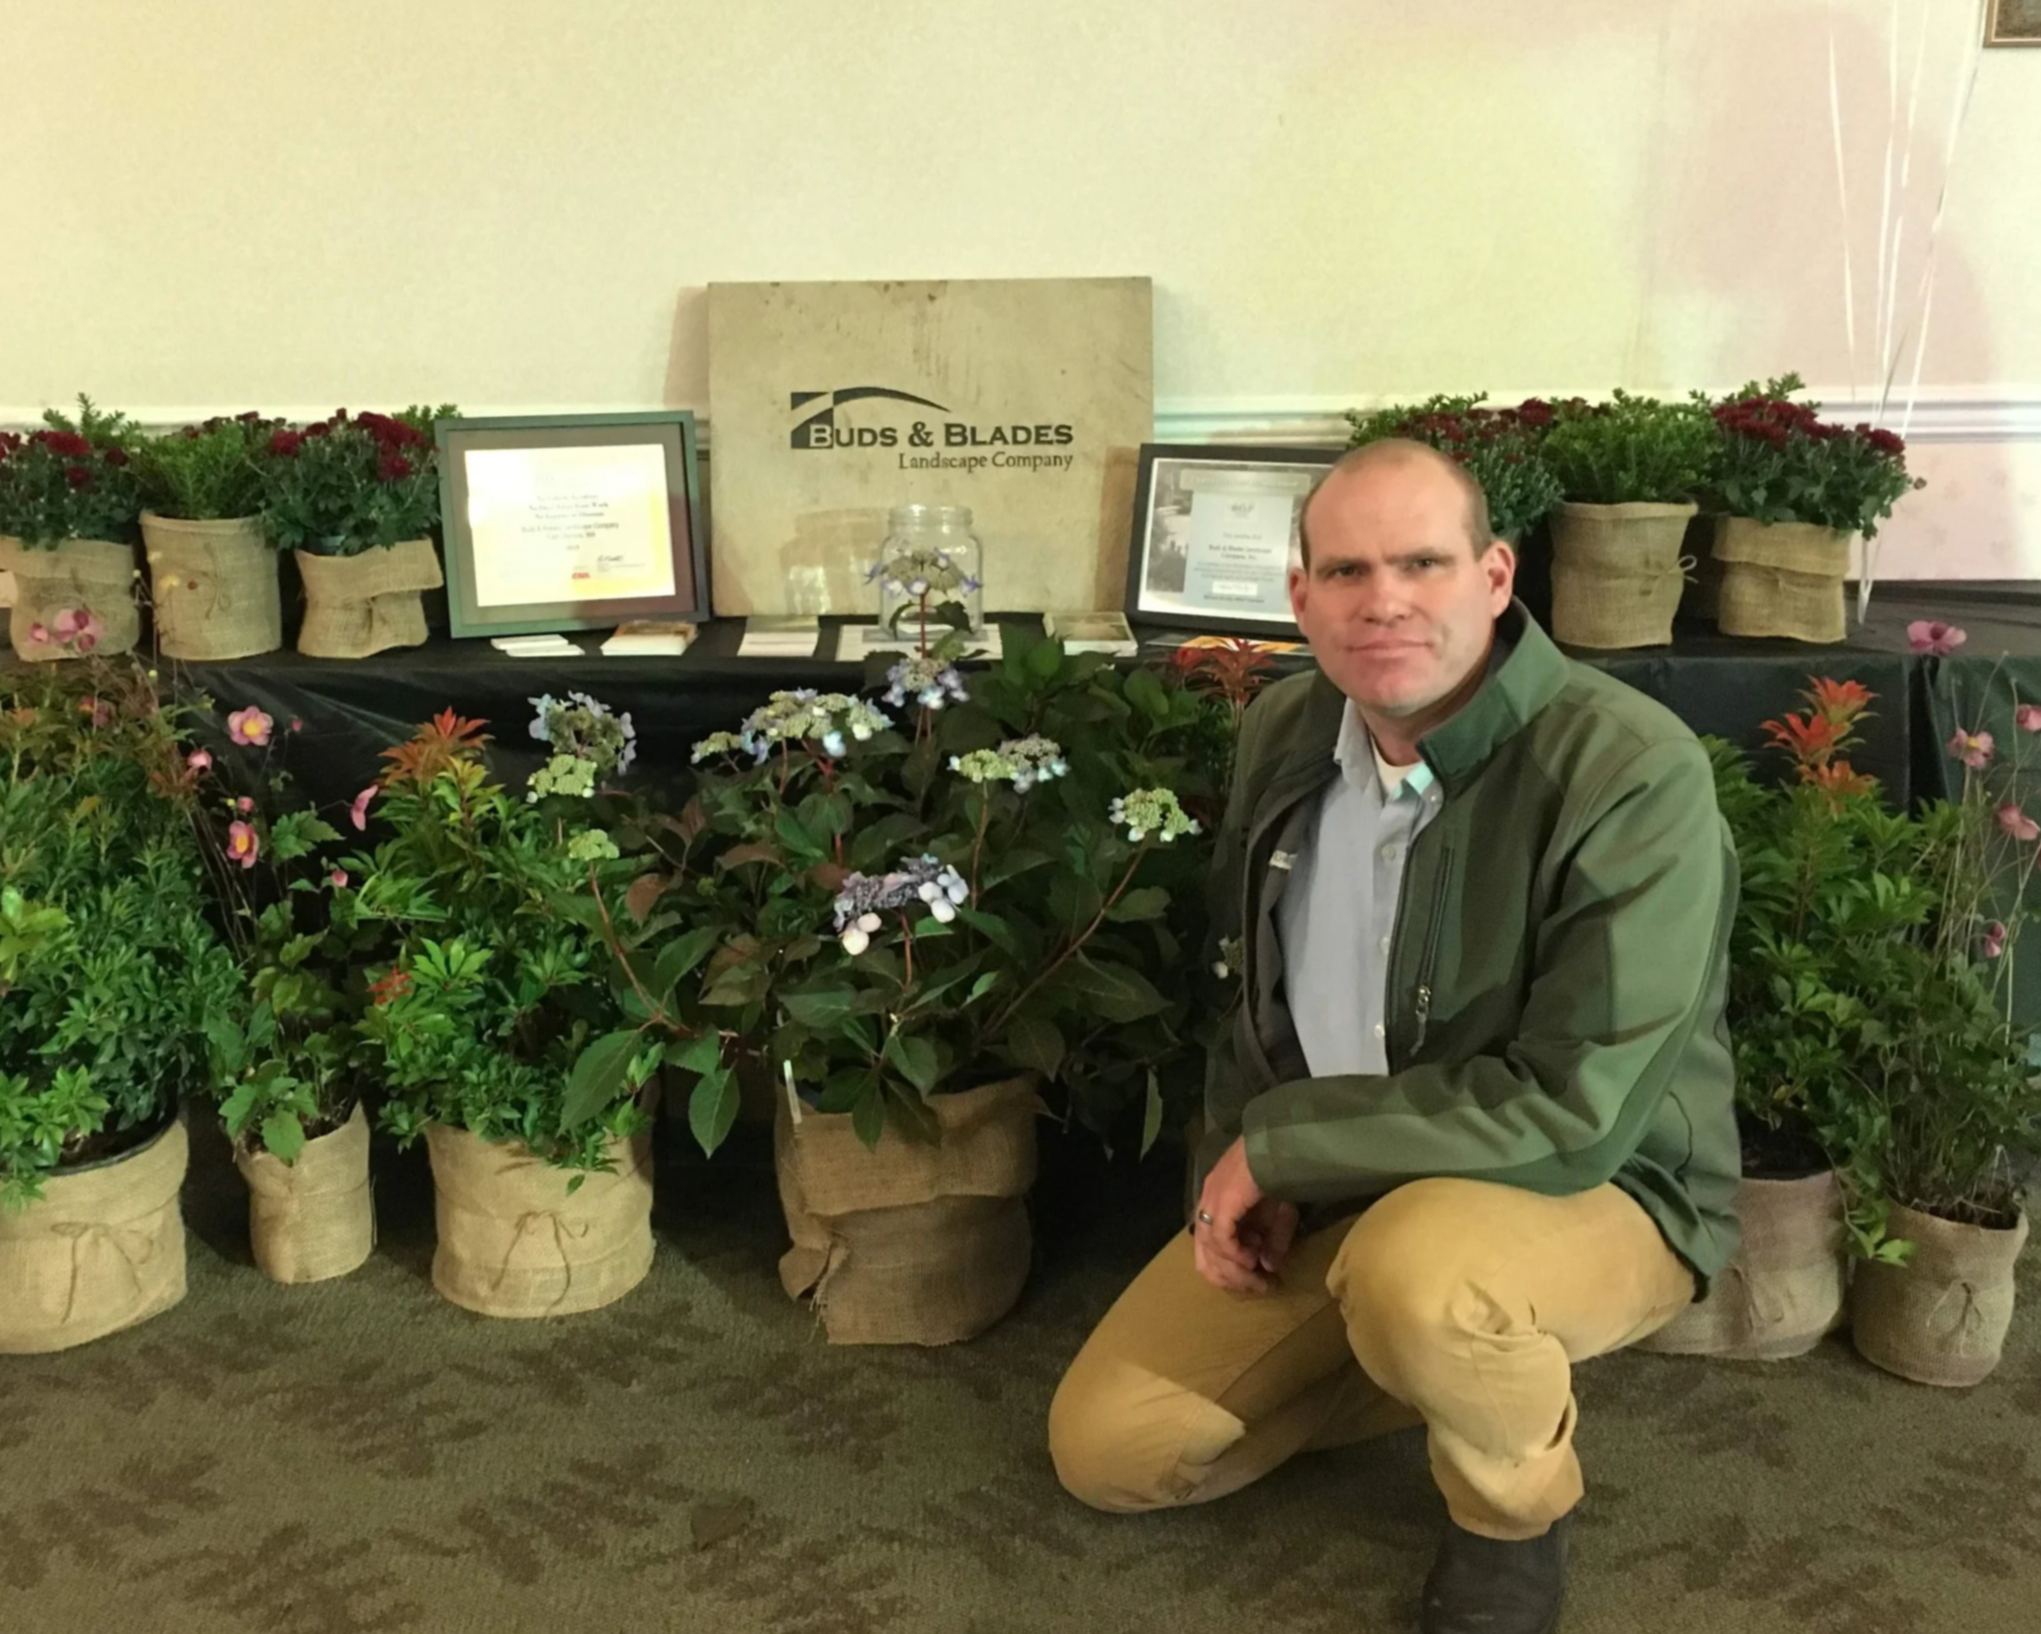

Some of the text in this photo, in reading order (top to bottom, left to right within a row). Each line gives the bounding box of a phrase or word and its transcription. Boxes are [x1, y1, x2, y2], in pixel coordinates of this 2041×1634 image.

[809, 421, 1073, 448] BUDS & BLADES
[899, 452, 1073, 473] Landscape Company
